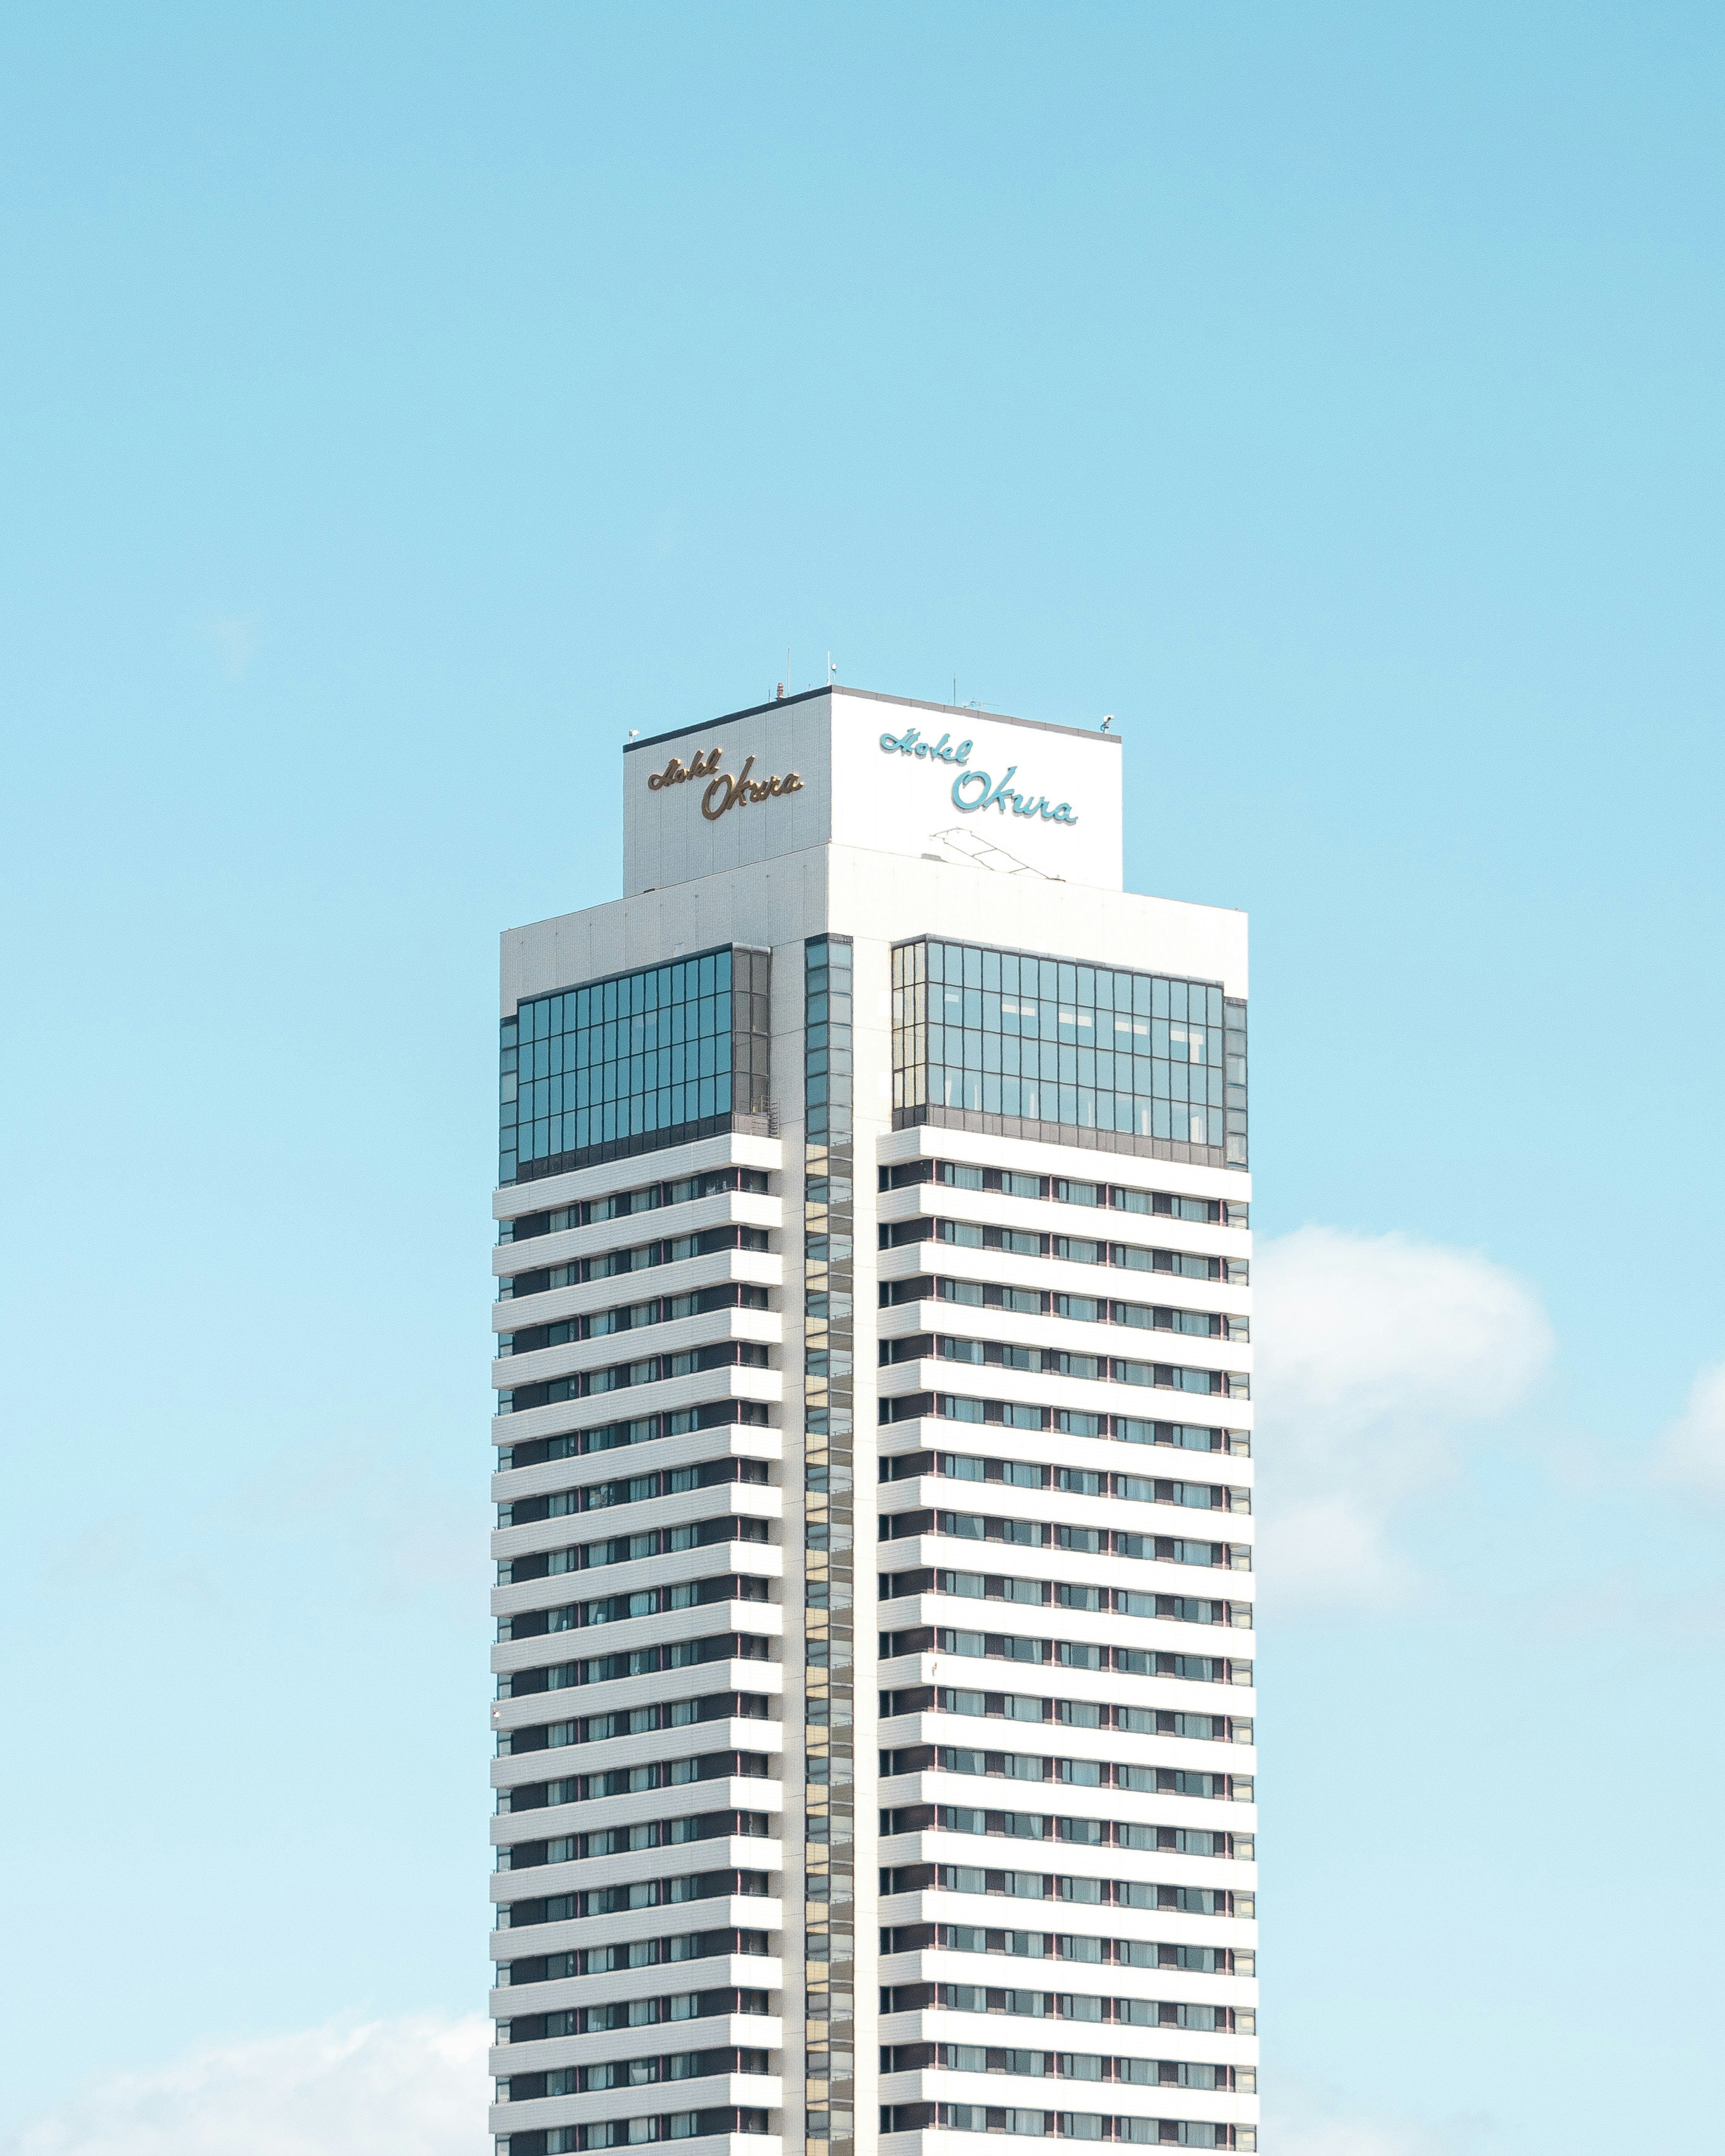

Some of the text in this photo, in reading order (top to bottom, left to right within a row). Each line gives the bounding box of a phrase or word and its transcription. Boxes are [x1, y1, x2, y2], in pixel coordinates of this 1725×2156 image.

[880, 728, 973, 764] Hotel
[701, 755, 805, 821] Okura
[952, 766, 1079, 823] Okura
